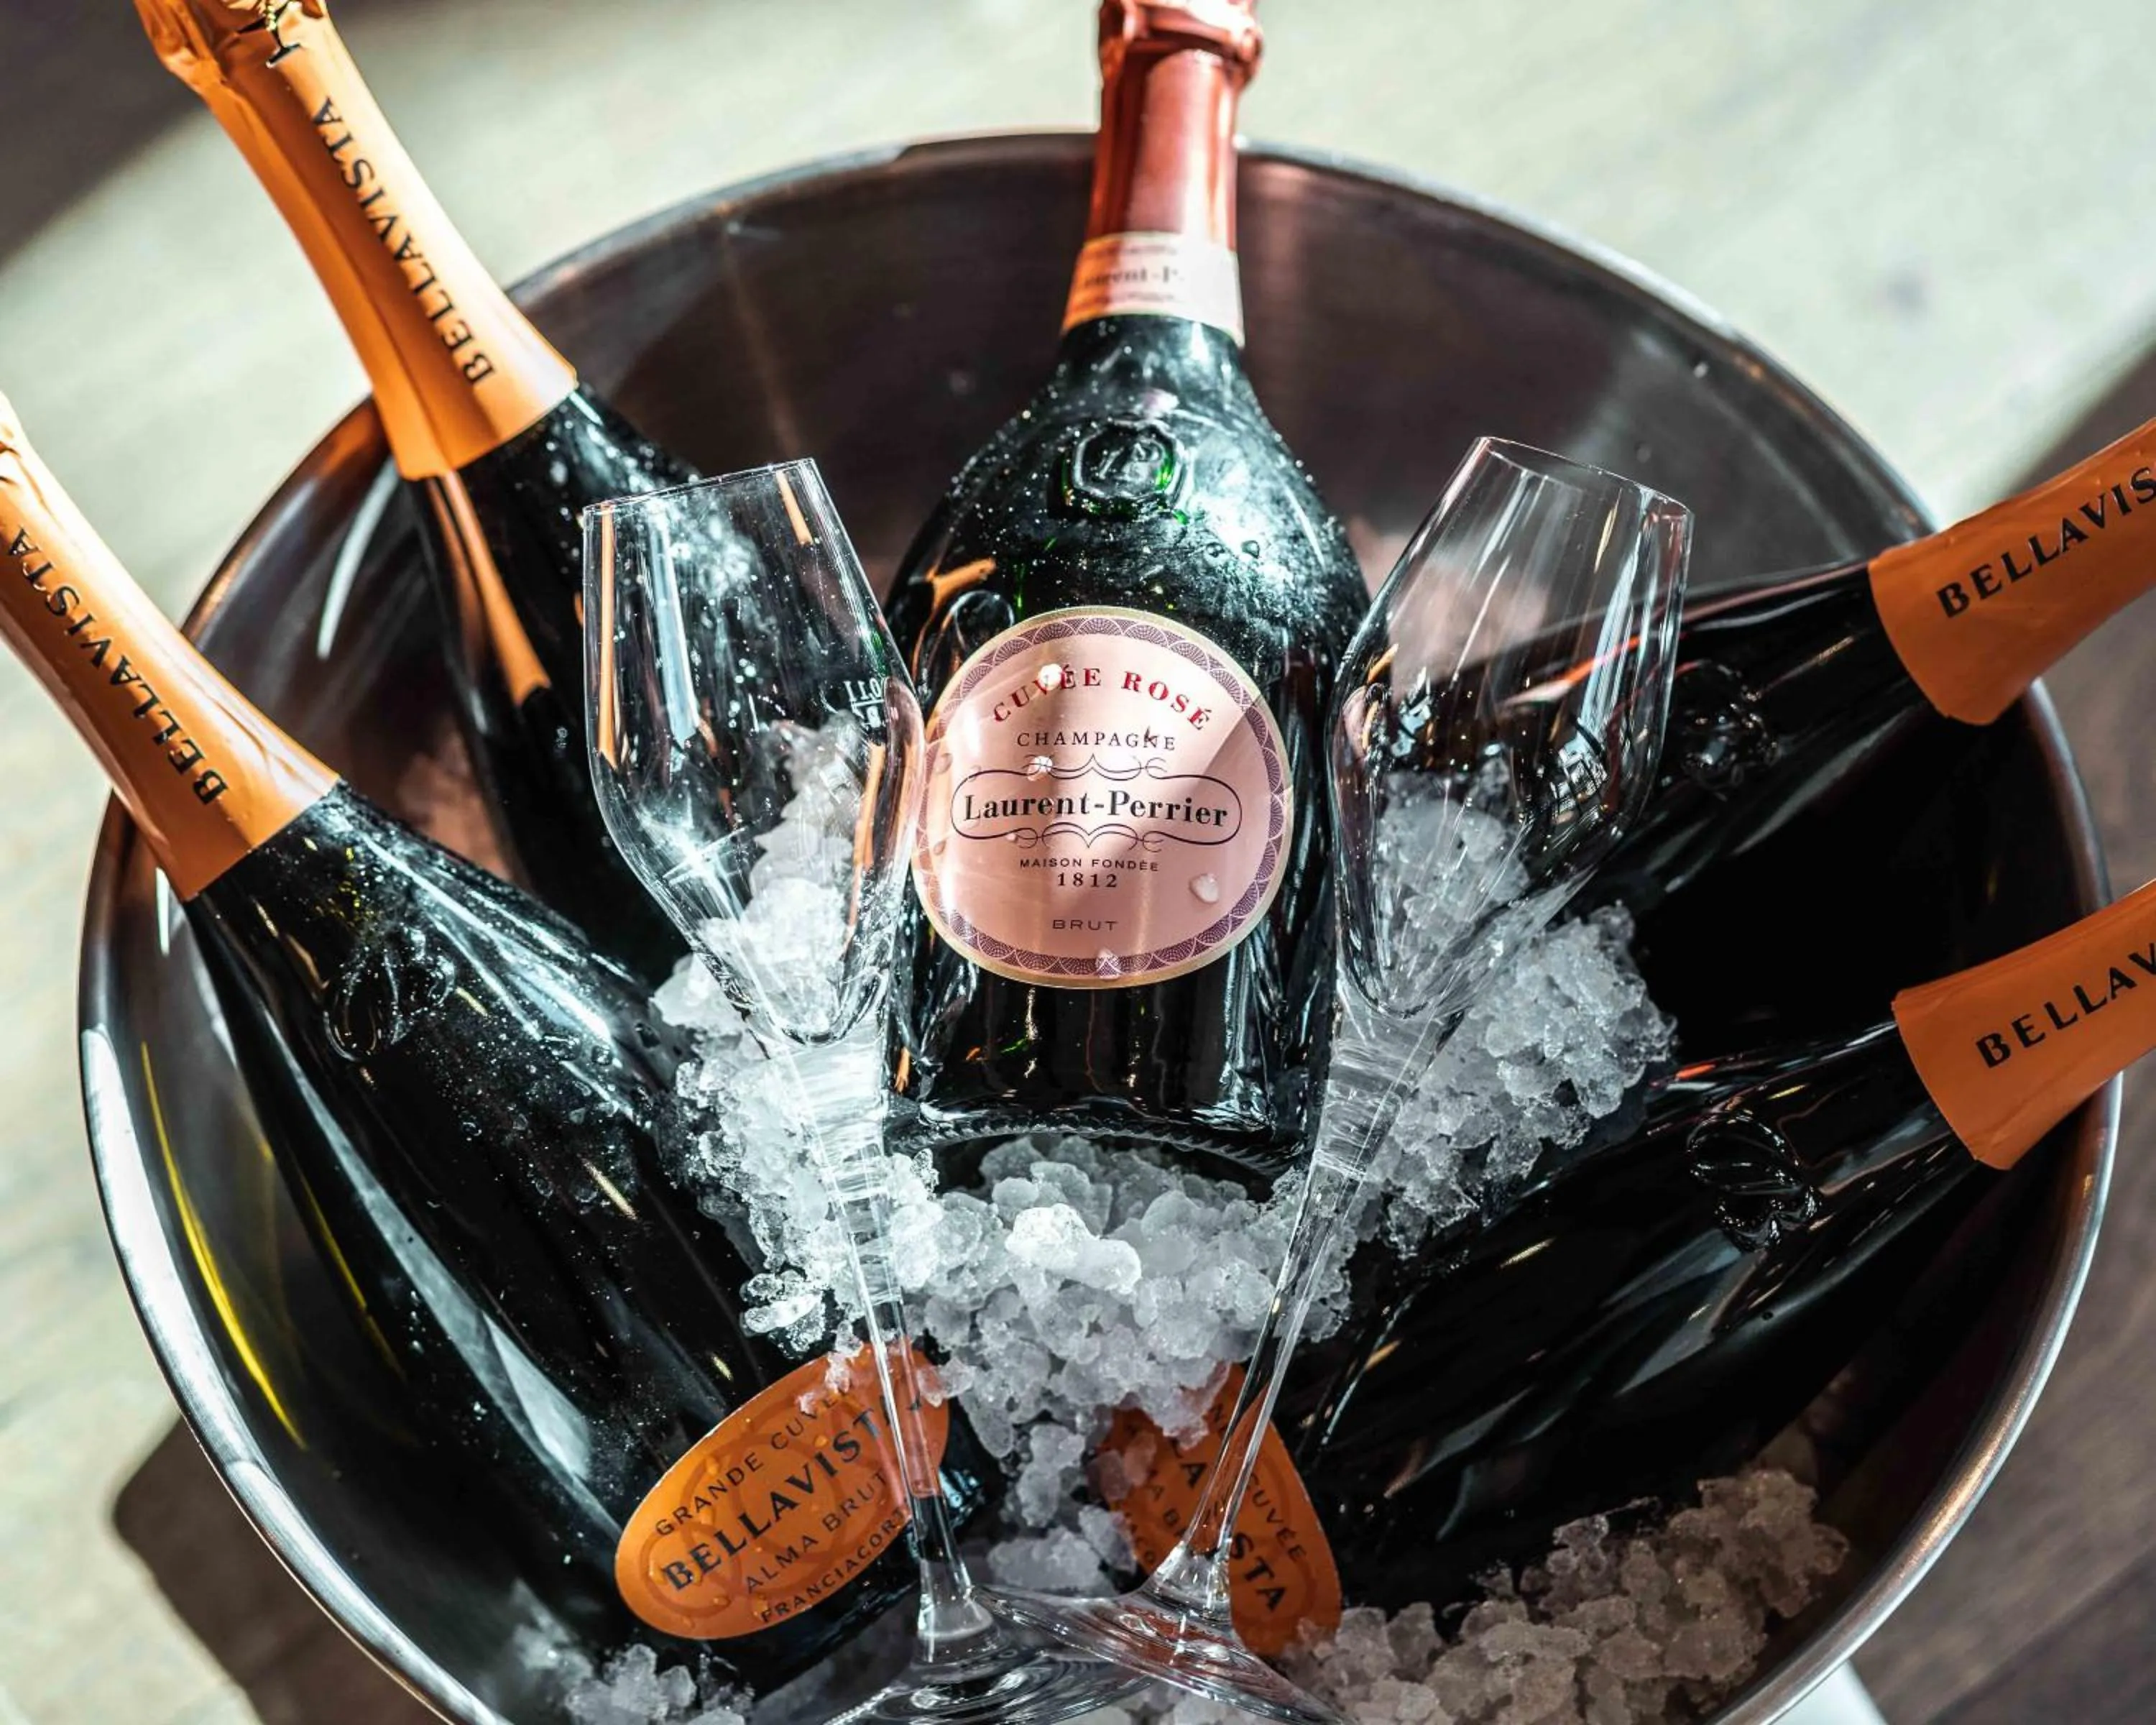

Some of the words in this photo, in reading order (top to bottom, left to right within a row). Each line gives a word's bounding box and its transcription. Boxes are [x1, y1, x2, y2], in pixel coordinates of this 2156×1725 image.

[311, 97, 494, 386] BELLAVISTA
[1936, 466, 2156, 619] BELLAVIS
[6, 527, 229, 805] BELLAVISTA
[1121, 671, 1212, 731] ROSÉ
[1017, 730, 1176, 752] CHAMPAGNE
[963, 789, 1228, 828] Laurent-Perrier
[1019, 857, 1082, 868] MAISON
[1091, 858, 1159, 872] FONDÉE
[1056, 873, 1118, 888] 1812
[1052, 919, 1119, 932] BRUT
[1976, 942, 2156, 1068] BELLAV
[655, 1452, 764, 1537] GRANDE
[745, 1534, 819, 1594] ALMA
[822, 1468, 888, 1532] BRUT
[761, 1506, 906, 1623] FRANCIACORT
